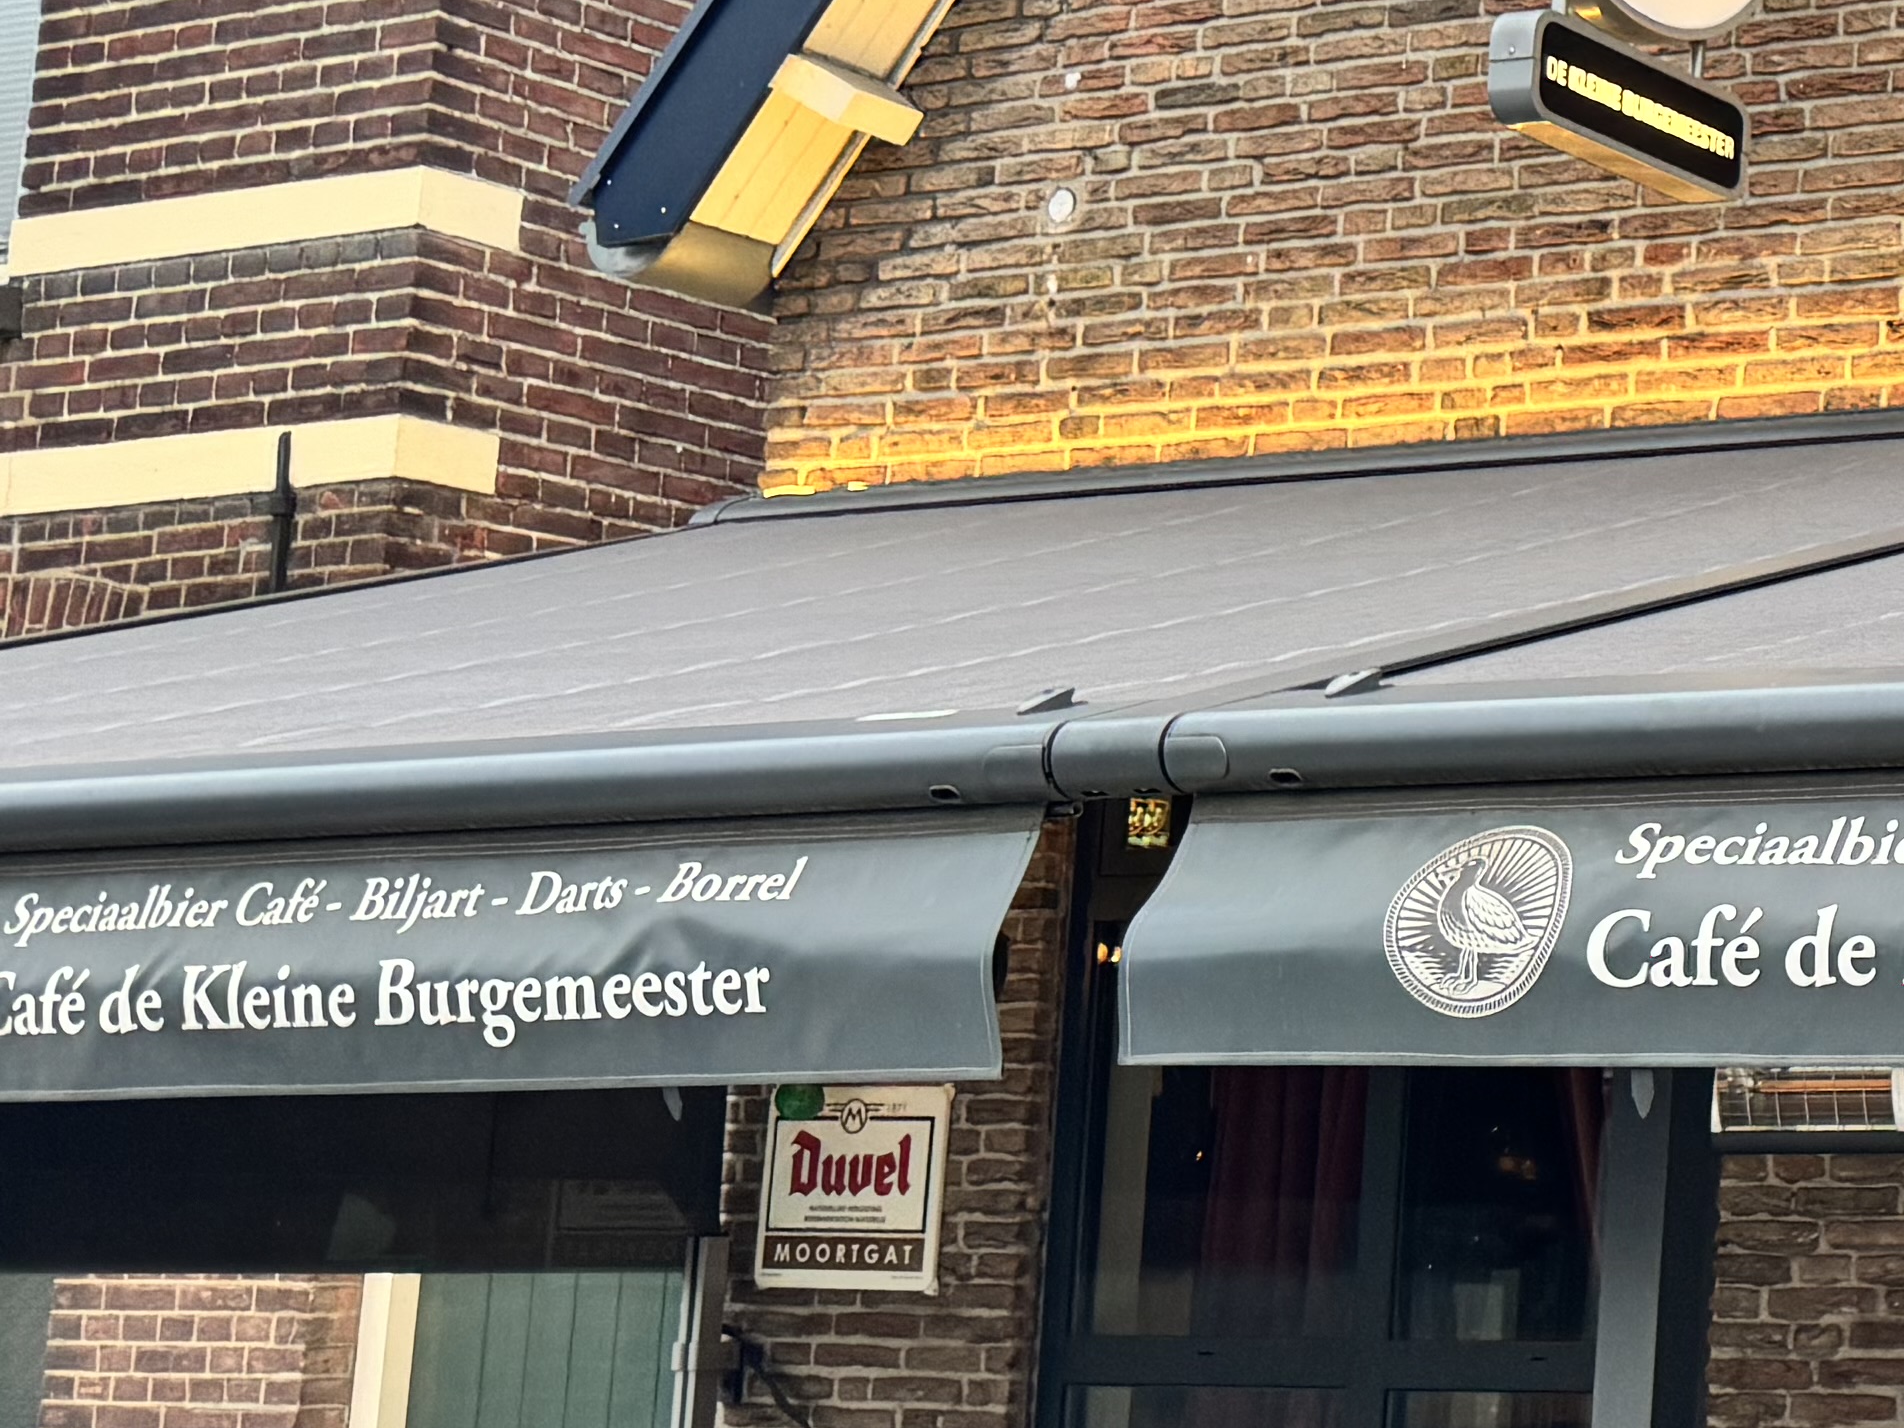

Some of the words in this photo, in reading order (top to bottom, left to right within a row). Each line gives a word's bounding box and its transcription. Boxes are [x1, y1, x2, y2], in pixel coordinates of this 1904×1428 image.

[1546, 55, 1569, 87] DE
[4, 884, 229, 948] Speciaalbier
[235, 877, 327, 927] Café
[349, 873, 485, 935] Biljart
[515, 871, 628, 916] Darts
[656, 855, 809, 903] Borrel
[1586, 903, 1763, 988] Café
[1785, 903, 1876, 988] de
[99, 963, 164, 1034] de
[181, 960, 356, 1030] Kleine
[374, 958, 770, 1048] Burgemeester
[789, 1129, 912, 1197] Duvel
[774, 1242, 913, 1265] MOORTGAT
